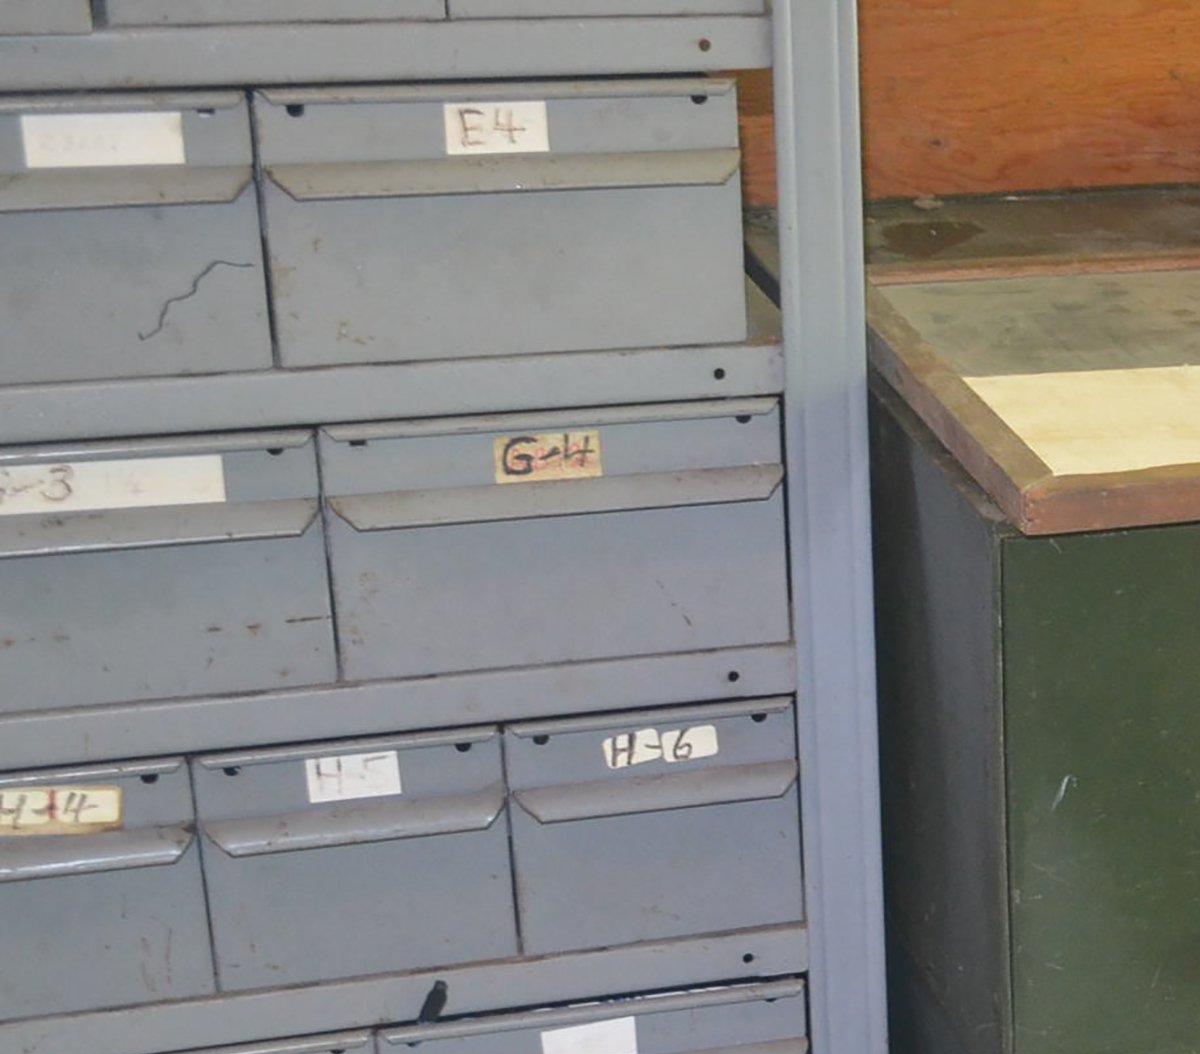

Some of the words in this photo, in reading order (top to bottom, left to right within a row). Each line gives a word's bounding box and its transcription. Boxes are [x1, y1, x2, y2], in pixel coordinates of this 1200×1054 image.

[458, 107, 526, 148] E4
[502, 433, 596, 475] G-4
[611, 729, 694, 767] H-6
